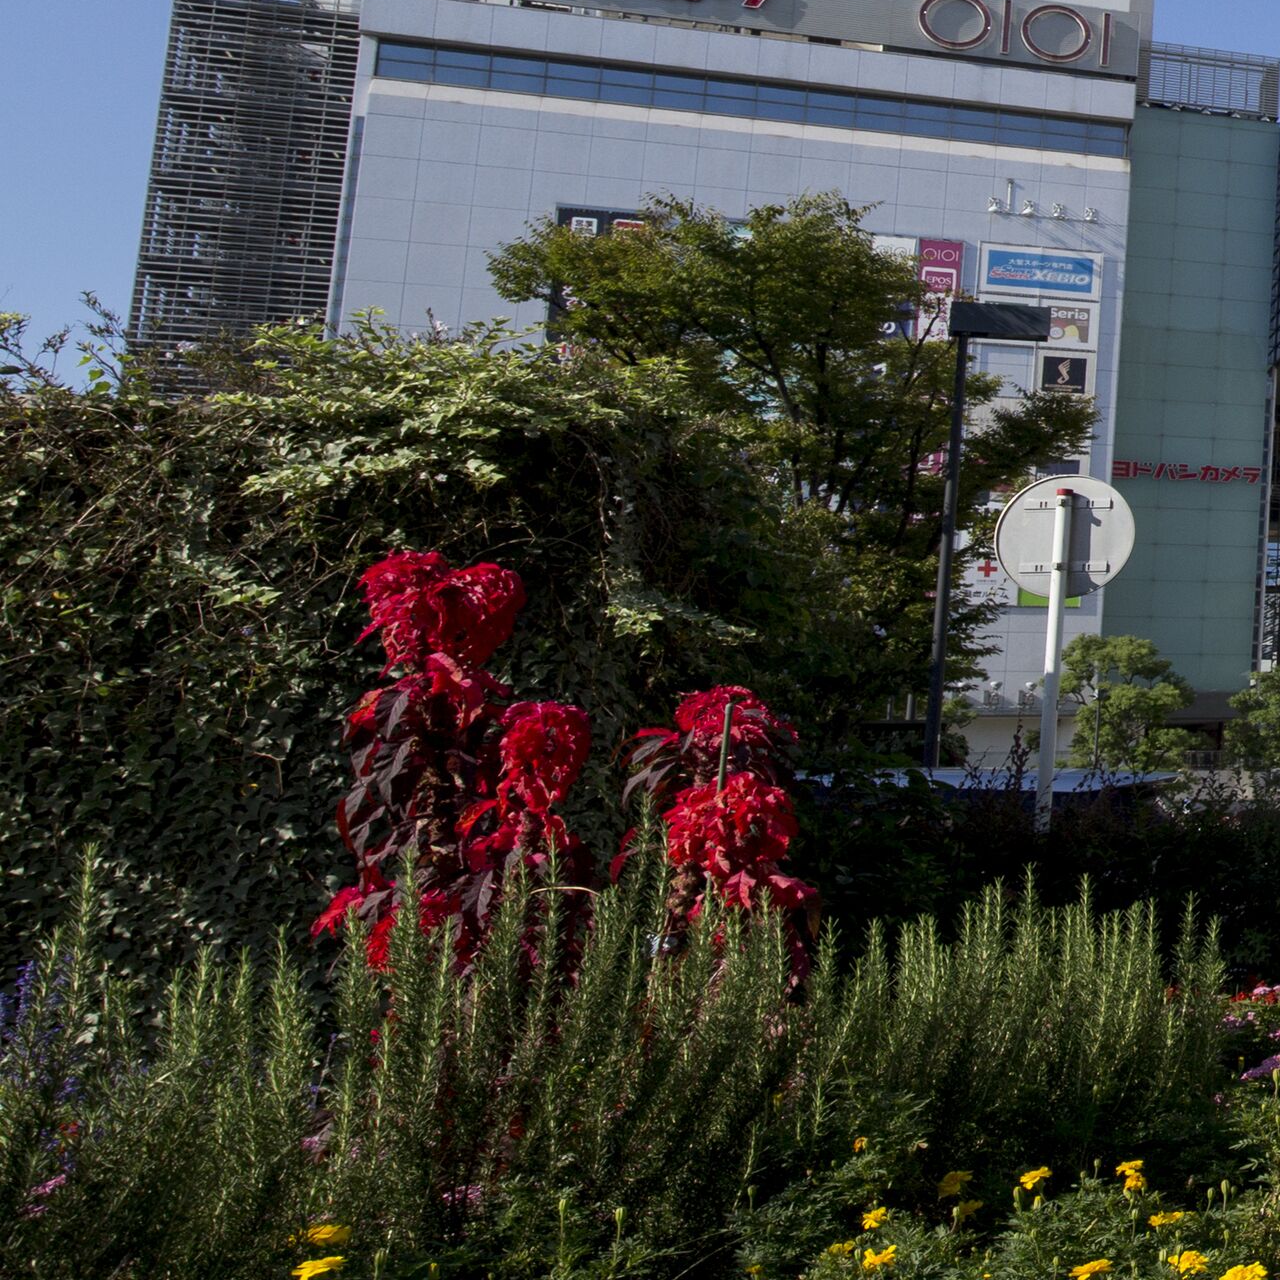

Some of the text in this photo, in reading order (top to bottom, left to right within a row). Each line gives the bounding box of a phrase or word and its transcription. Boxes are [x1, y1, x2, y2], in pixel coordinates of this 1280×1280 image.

[926, 275, 952, 286] EPOS
[1051, 307, 1089, 320] Seria
[1112, 460, 1262, 485] ヨドバシカメラ
